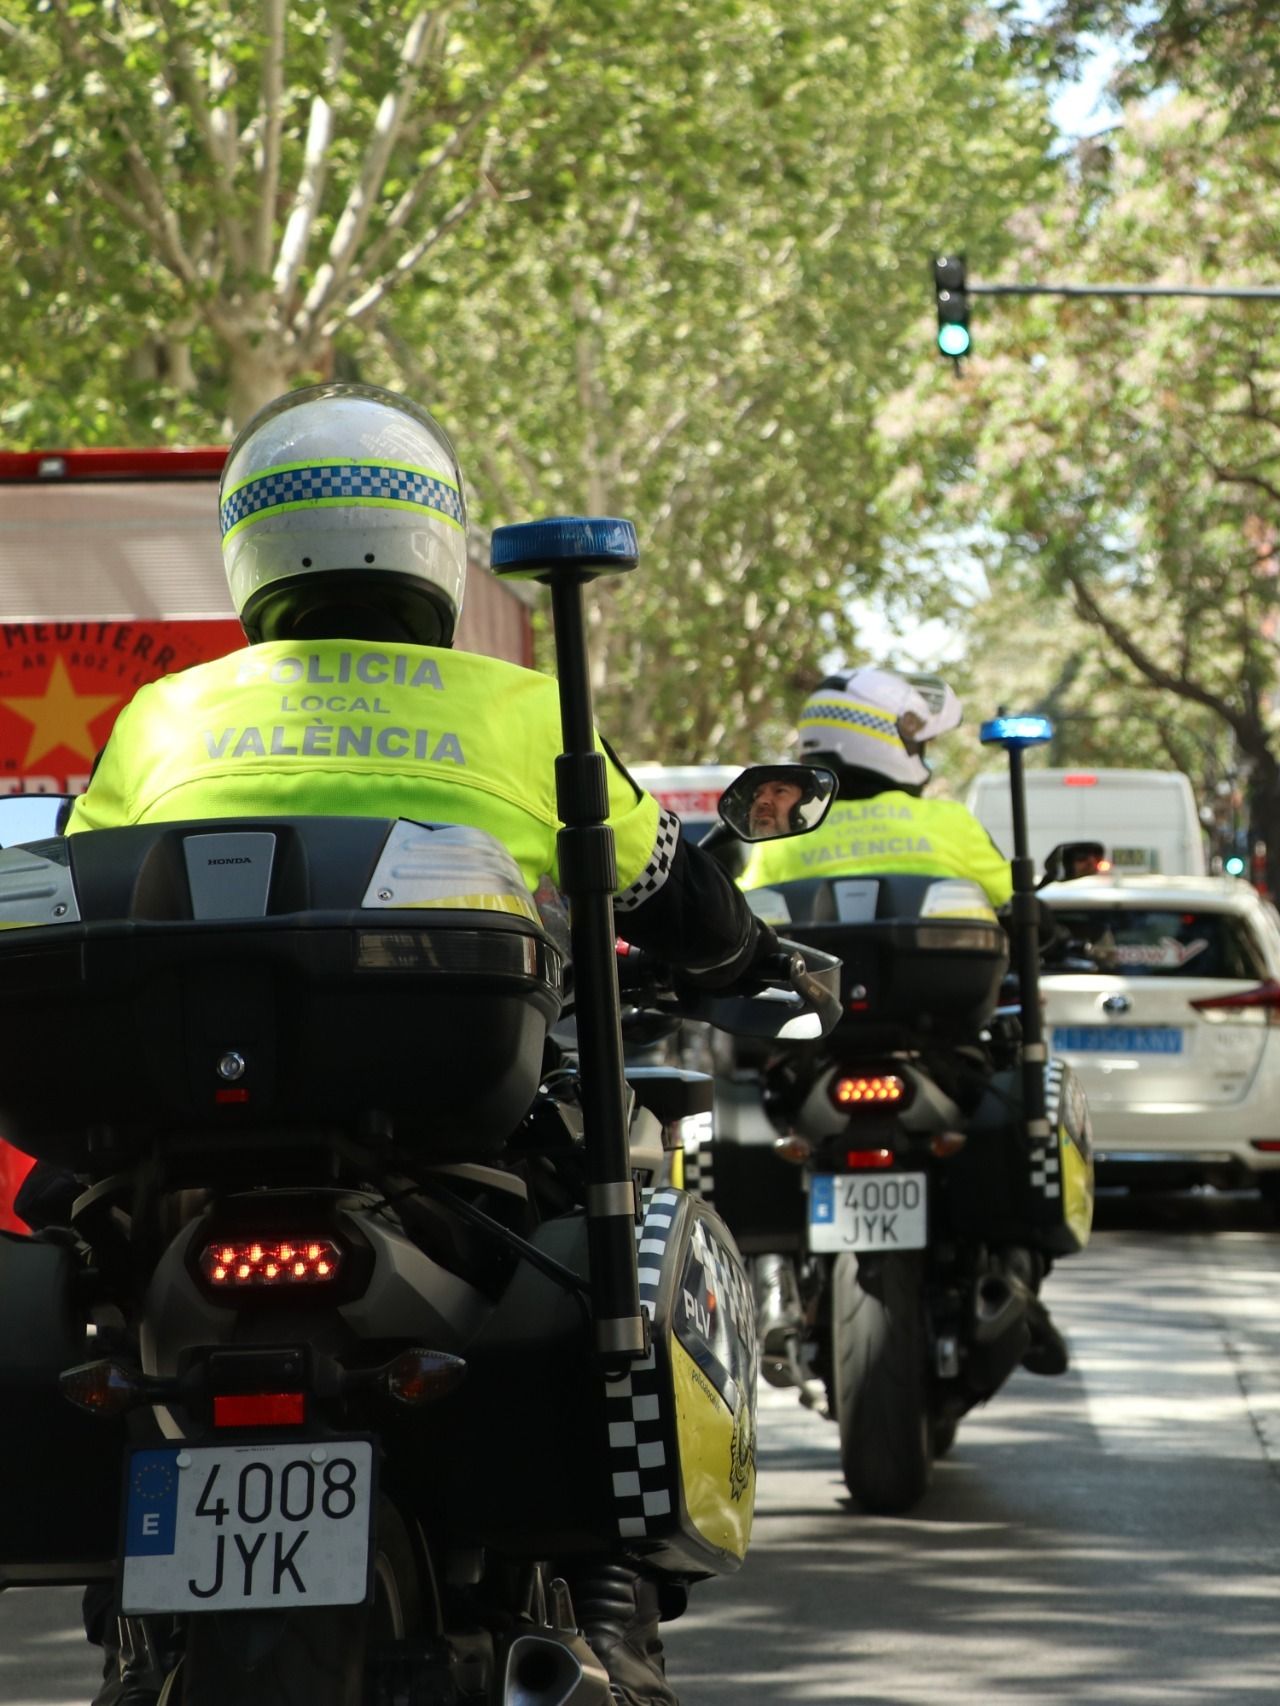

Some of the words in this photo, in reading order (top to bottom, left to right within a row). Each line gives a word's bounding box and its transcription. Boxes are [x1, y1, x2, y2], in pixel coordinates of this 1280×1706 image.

[234, 651, 445, 691] POLICIA
[280, 695, 391, 714] LOCAL
[204, 718, 466, 766] VALÈNCIA
[828, 801, 913, 826] OLICIA
[207, 857, 252, 866] HONDA
[816, 1202, 829, 1218] E
[843, 1179, 921, 1212] 4000
[842, 1214, 899, 1245] JYK
[683, 1288, 711, 1340] PLV
[195, 1457, 357, 1527] 4008
[141, 1512, 161, 1536] E
[187, 1529, 310, 1599] JYK
